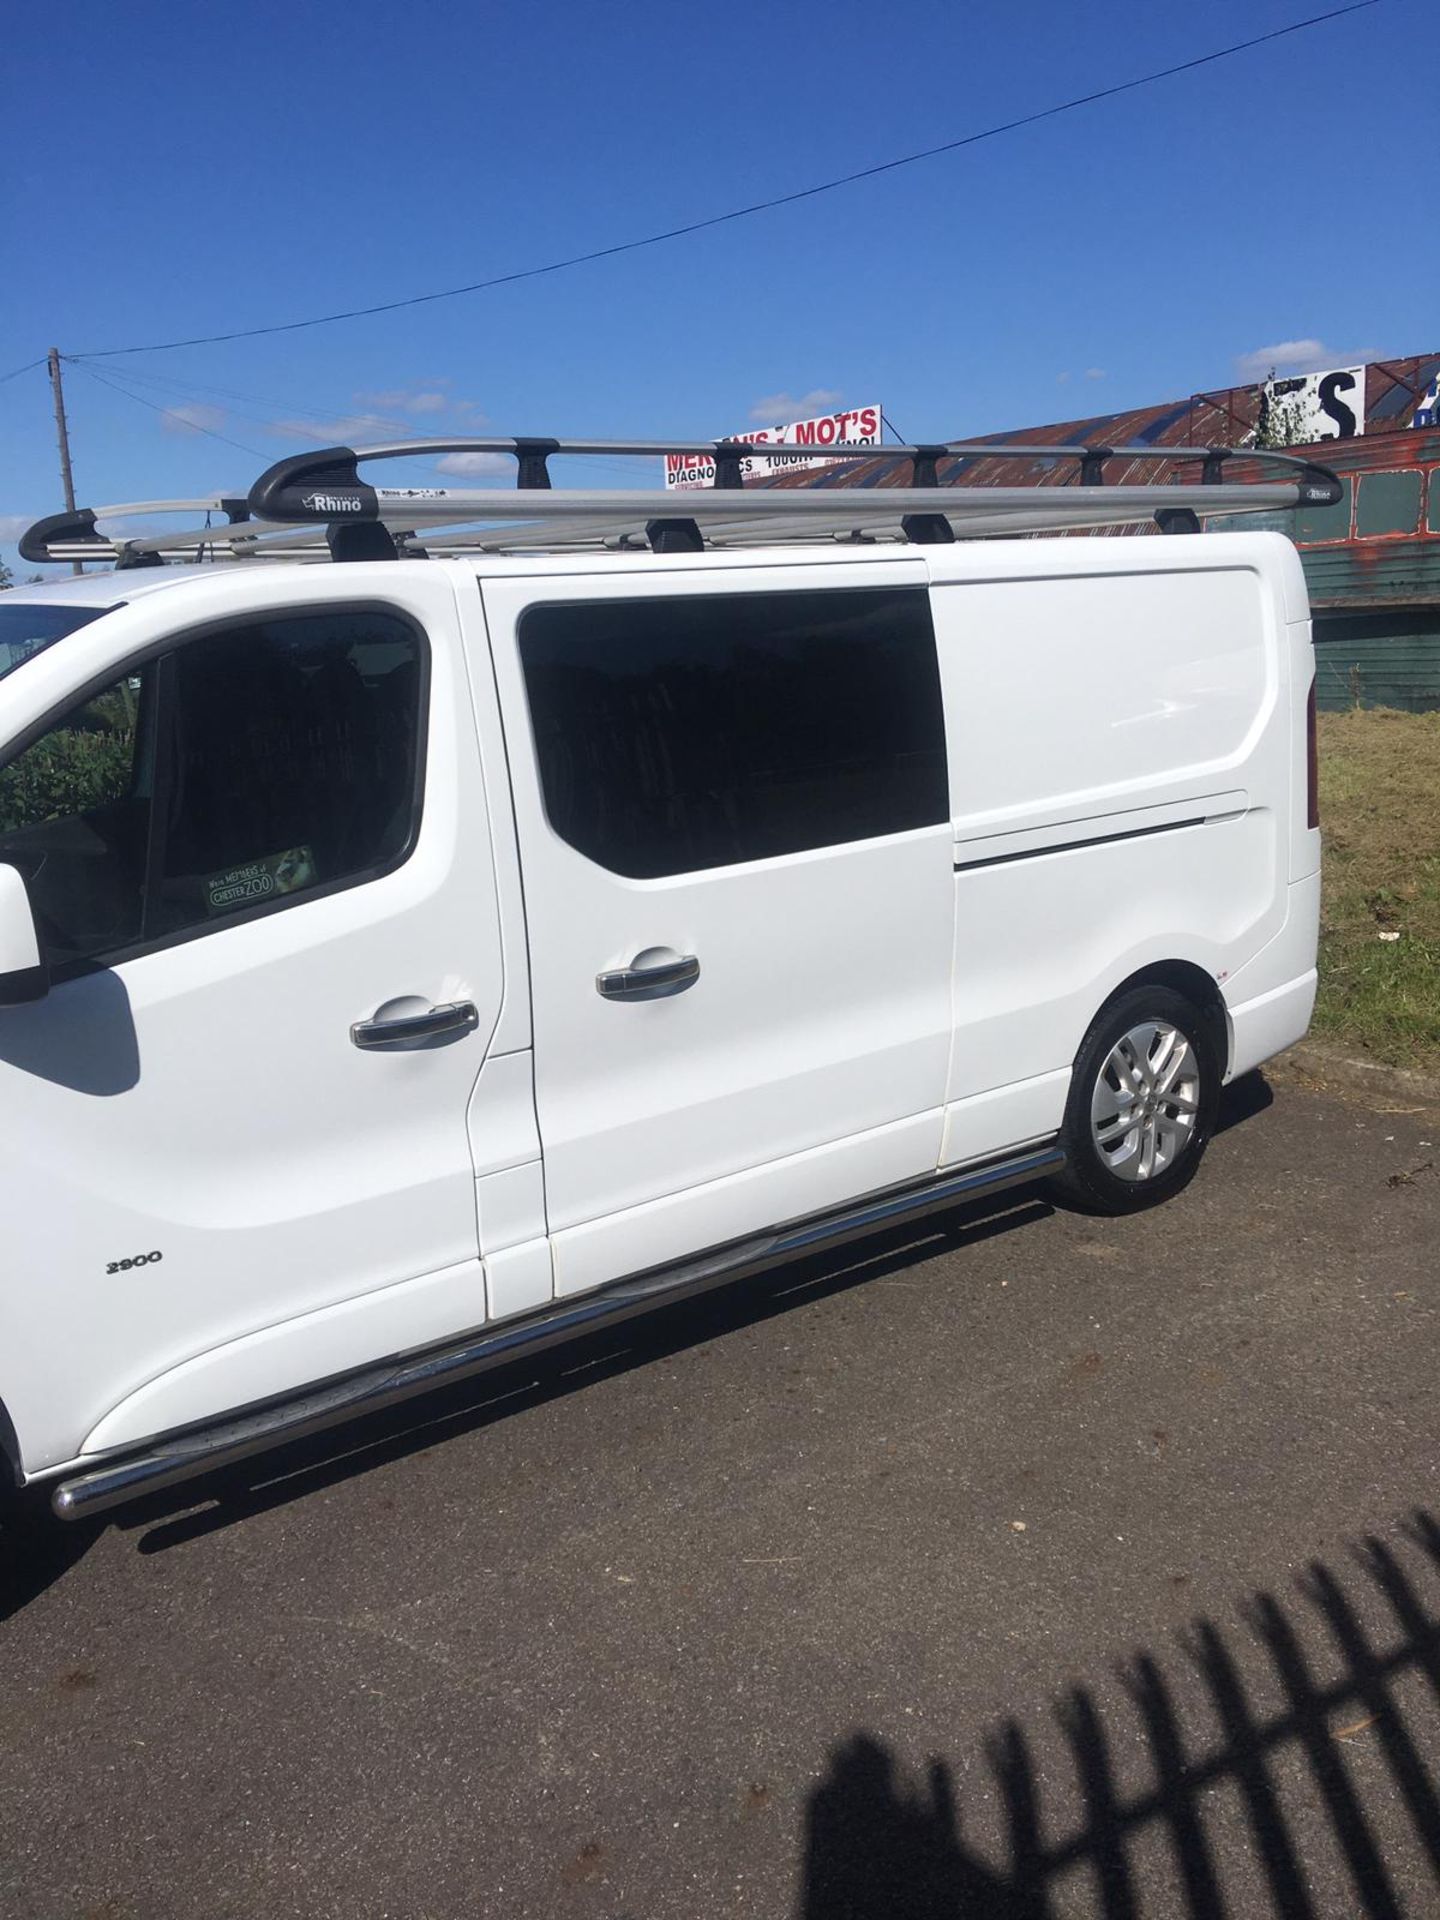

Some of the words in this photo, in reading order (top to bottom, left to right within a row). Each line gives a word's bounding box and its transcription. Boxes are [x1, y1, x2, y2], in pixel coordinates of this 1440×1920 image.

[796, 408, 877, 445] MOT'S
[314, 496, 362, 511] Rhino
[213, 886, 245, 903] CHESTER
[243, 876, 270, 896] ZOO
